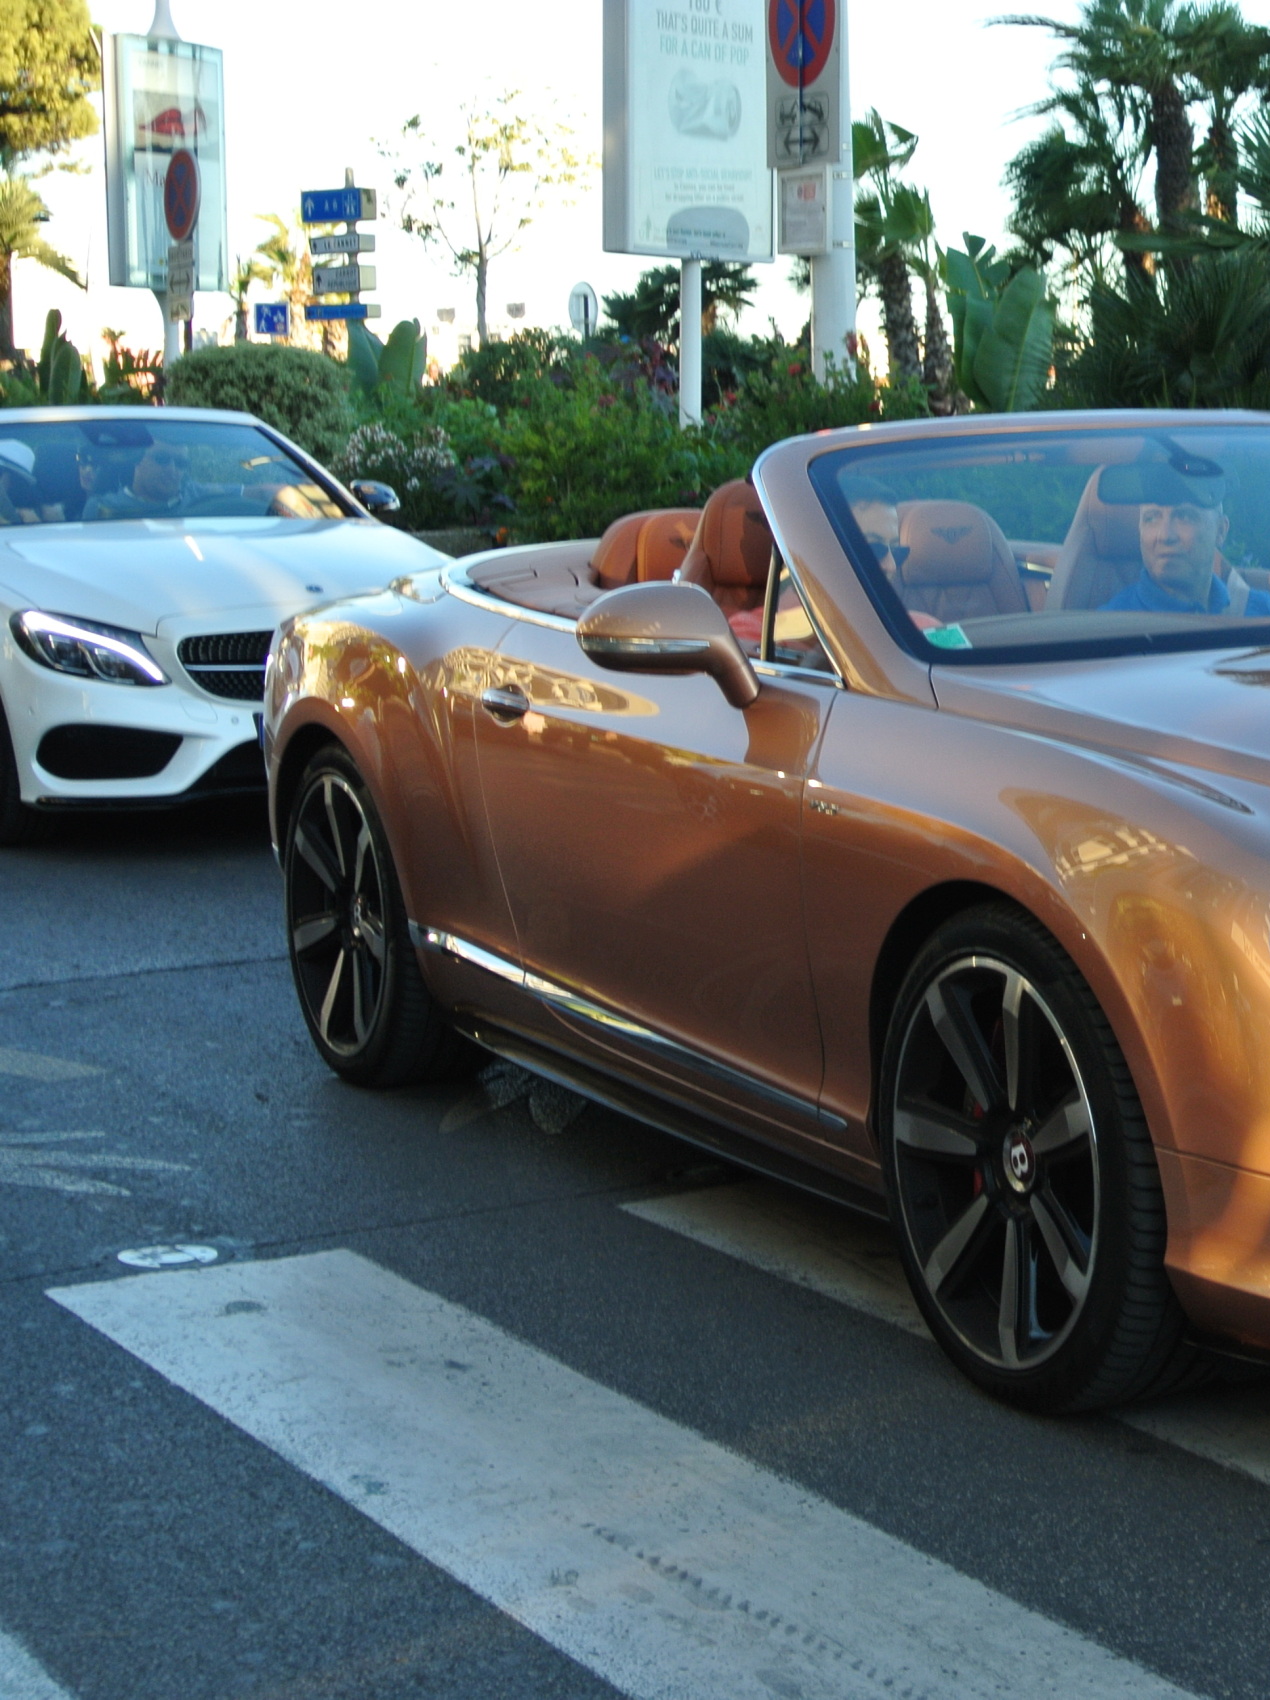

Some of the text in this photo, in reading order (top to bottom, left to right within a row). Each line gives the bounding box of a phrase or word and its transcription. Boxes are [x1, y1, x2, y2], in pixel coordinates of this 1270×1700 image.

[656, 9, 753, 43] THAT'S QUITE A SUM
[660, 34, 749, 66] FOR A CAN OF POP
